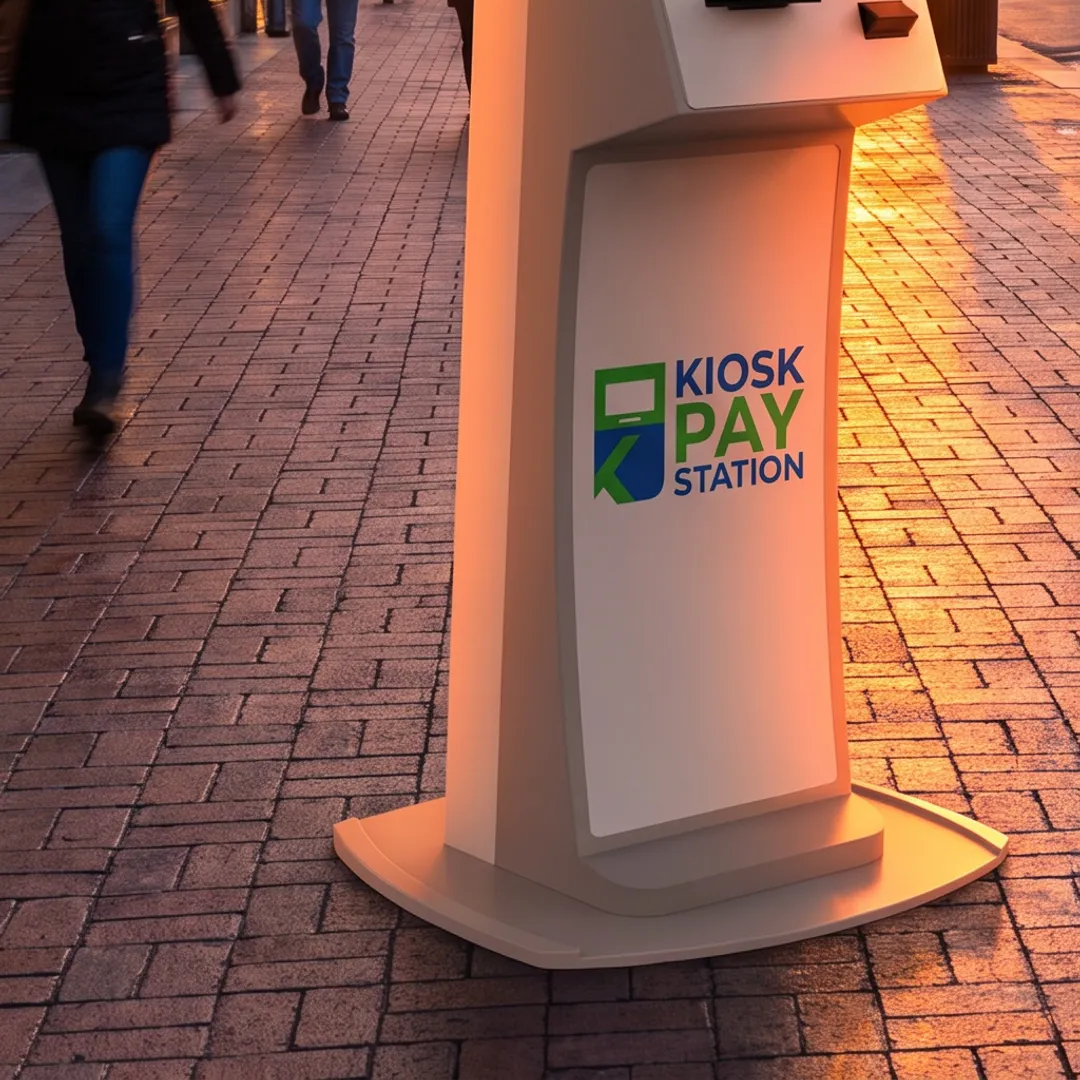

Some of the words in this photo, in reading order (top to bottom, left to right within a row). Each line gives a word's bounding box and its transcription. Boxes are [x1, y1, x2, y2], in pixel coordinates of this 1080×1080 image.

[675, 345, 805, 398] KIOSK
[675, 388, 805, 464] PAY
[673, 451, 804, 497] STATION
